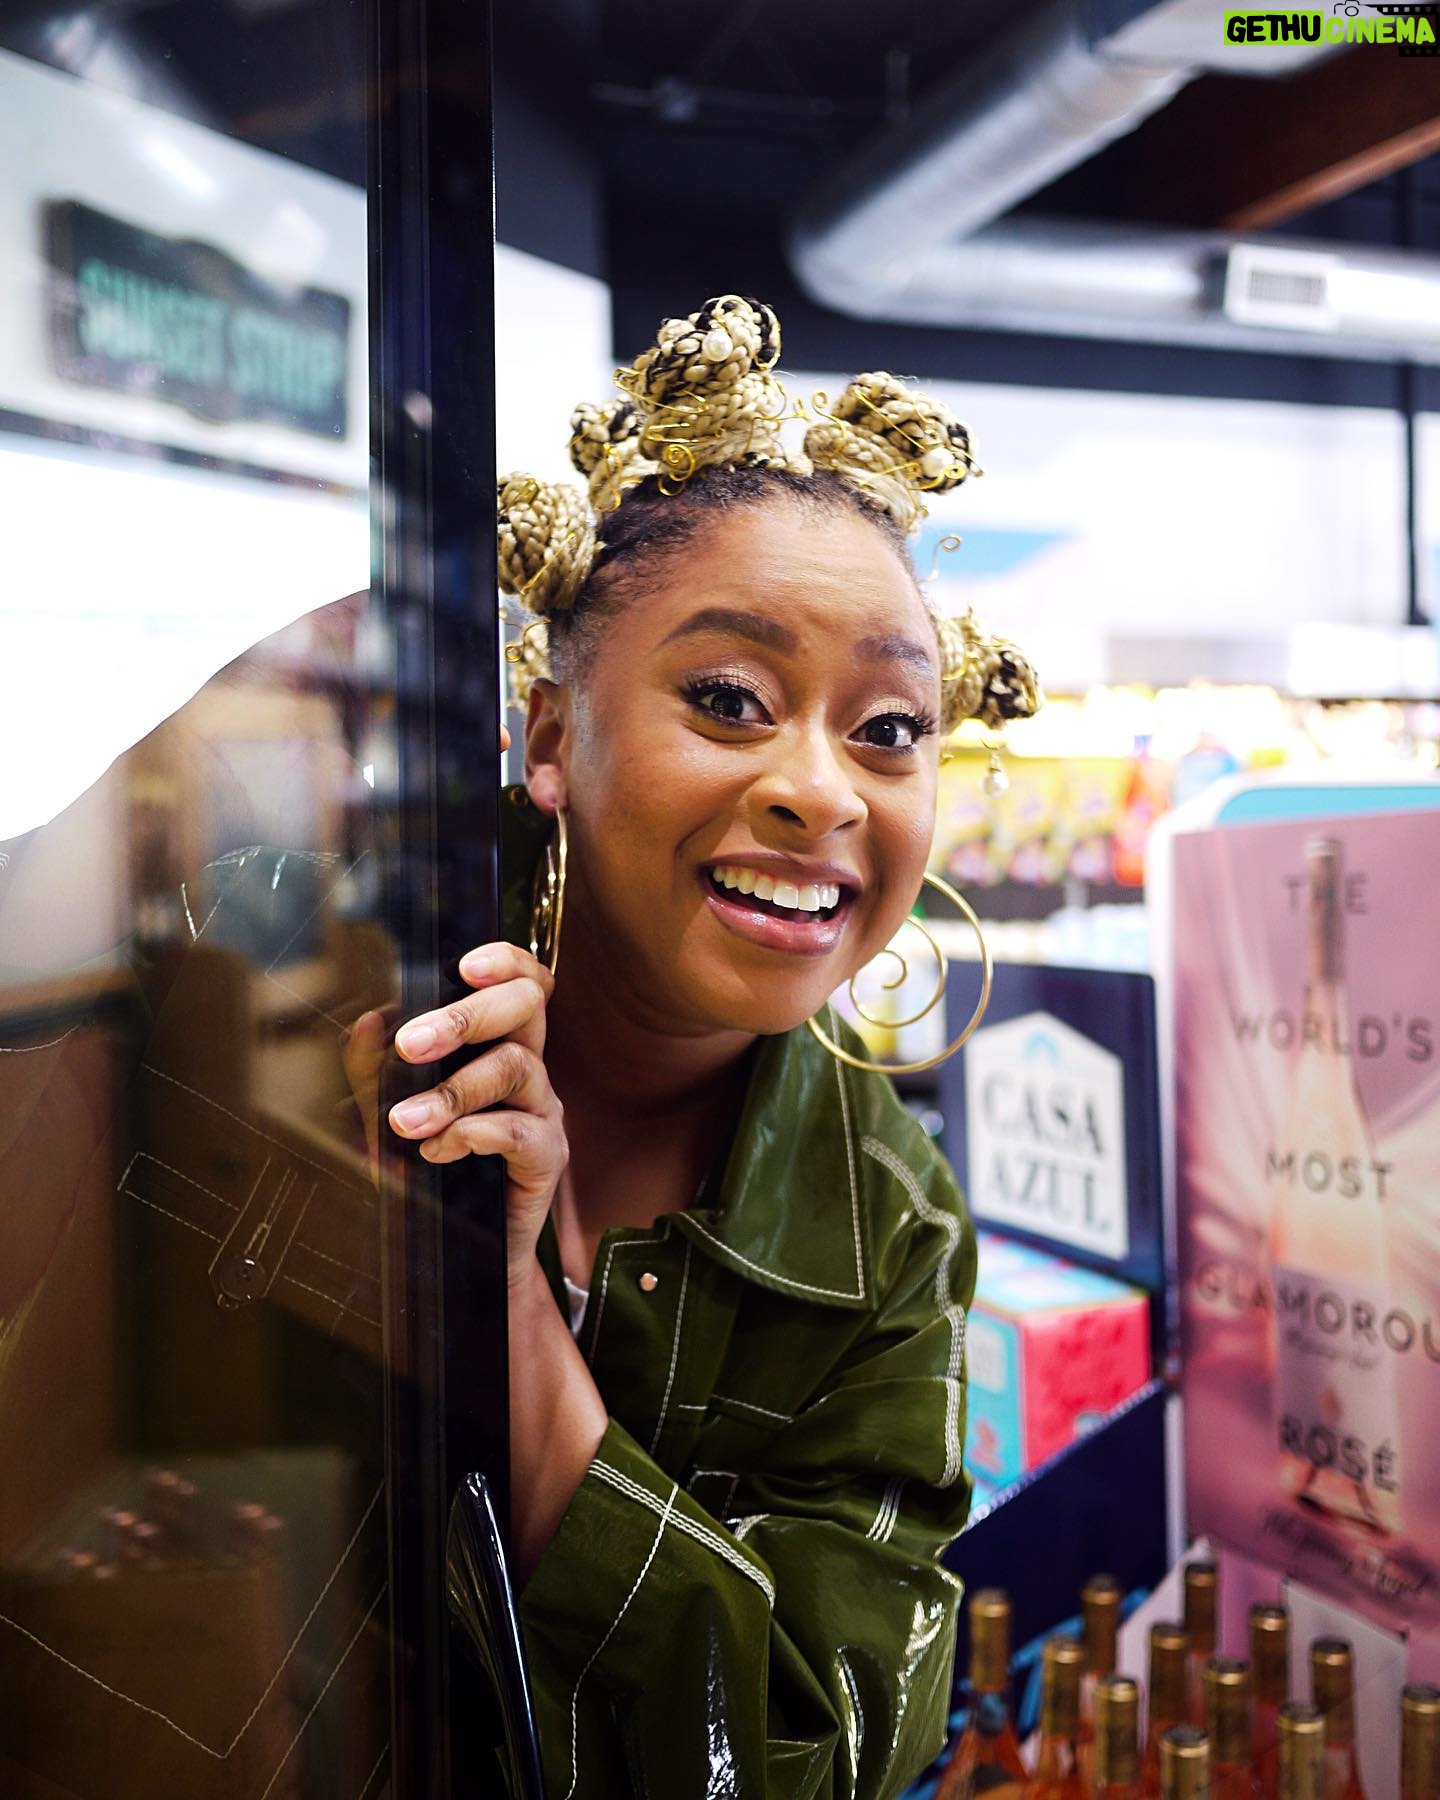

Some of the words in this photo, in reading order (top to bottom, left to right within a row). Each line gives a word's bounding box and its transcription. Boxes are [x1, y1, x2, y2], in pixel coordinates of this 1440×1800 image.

[1231, 1006, 1434, 1063] WORLD'S
[981, 1069, 1105, 1156] CASA
[985, 1148, 1112, 1235] AZUL
[1266, 1149, 1395, 1201] MOST
[1278, 1414, 1399, 1494] ROSÉ
